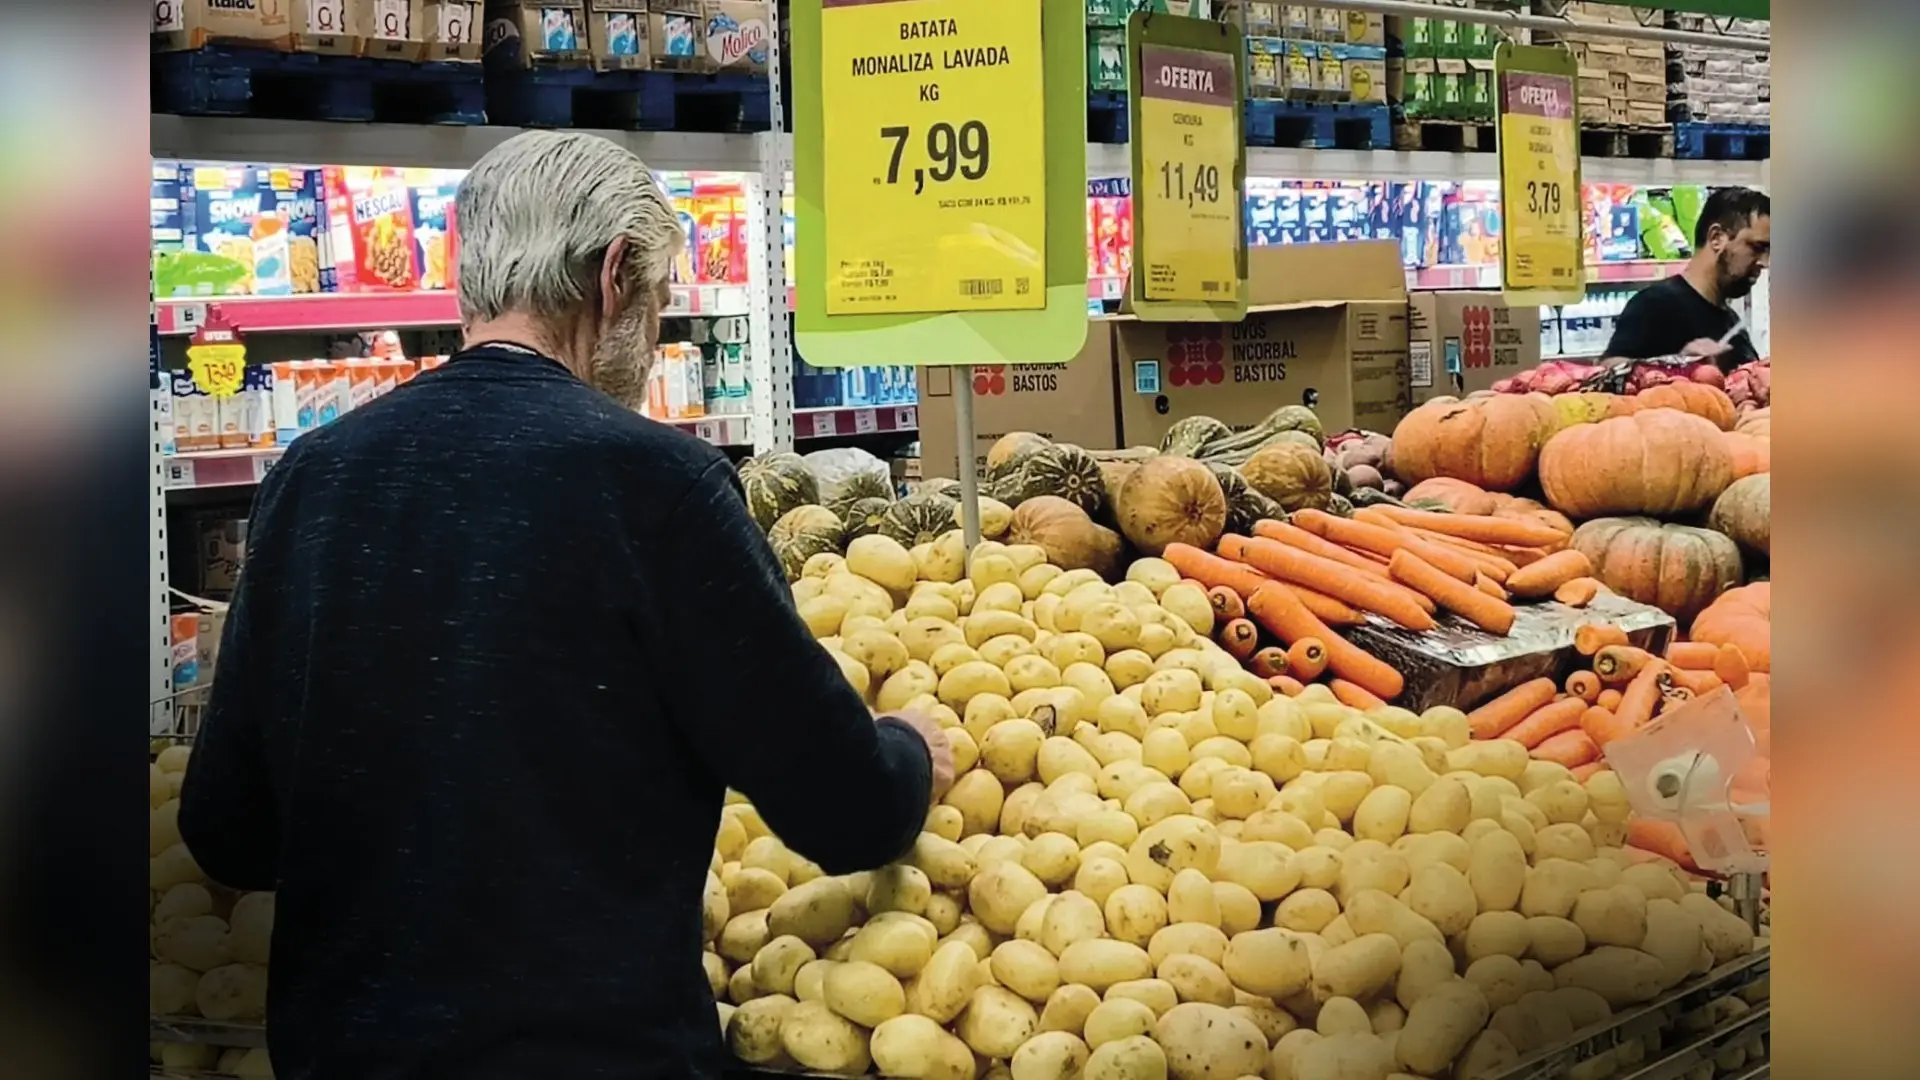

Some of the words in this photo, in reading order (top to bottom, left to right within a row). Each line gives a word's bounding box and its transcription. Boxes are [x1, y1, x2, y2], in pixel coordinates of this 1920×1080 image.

[900, 18, 957, 40] BATATA
[721, 25, 761, 63] Molico
[852, 52, 934, 76] MONALIZA
[943, 46, 1010, 69] LAVADA
[1161, 65, 1214, 93] OFERTA
[919, 83, 939, 101] KG
[1521, 86, 1558, 107] OFERTA
[880, 120, 989, 195] 7,99
[1161, 161, 1219, 209] 11,49
[1527, 181, 1560, 220] 3,79
[1233, 341, 1298, 361] INCORBAL
[1013, 373, 1057, 391] BASTOS
[1234, 362, 1285, 382] BASTOS
